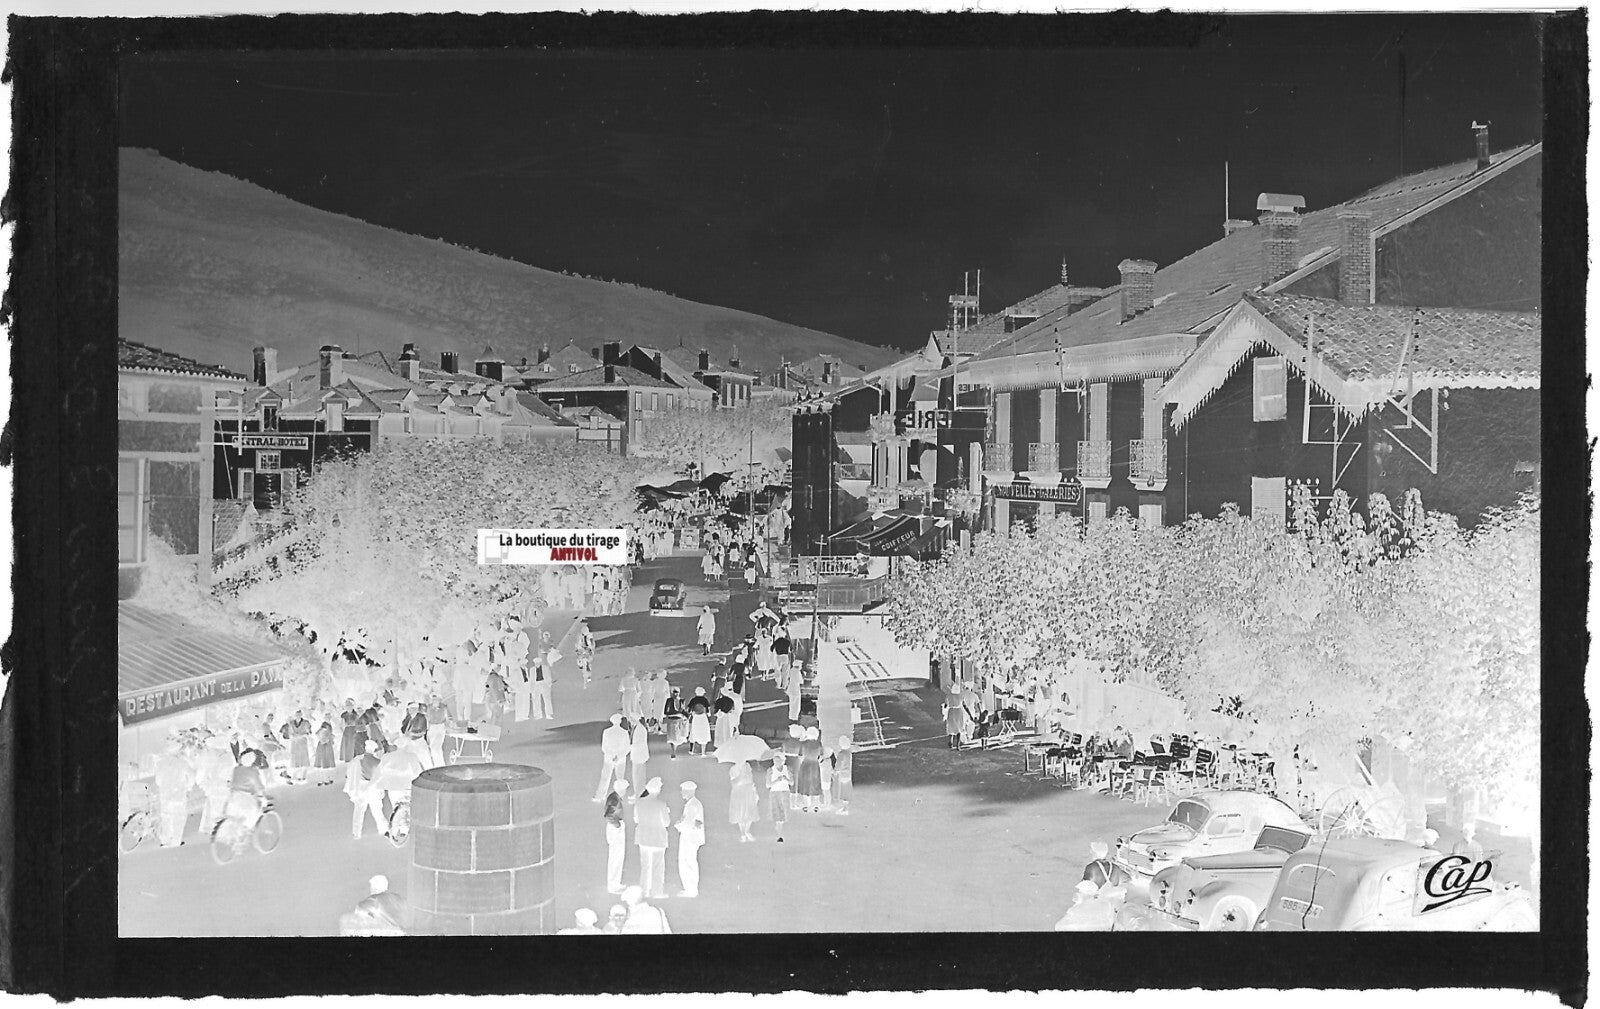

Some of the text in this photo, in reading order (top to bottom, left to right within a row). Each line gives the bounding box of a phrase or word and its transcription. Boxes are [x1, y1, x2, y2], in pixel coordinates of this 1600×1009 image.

[232, 437, 306, 447] CNTRAL HOTEL
[881, 530, 916, 551] COIFFEUR
[125, 680, 217, 716] RESTAURANT
[220, 681, 232, 693] DE
[233, 680, 246, 692] LA
